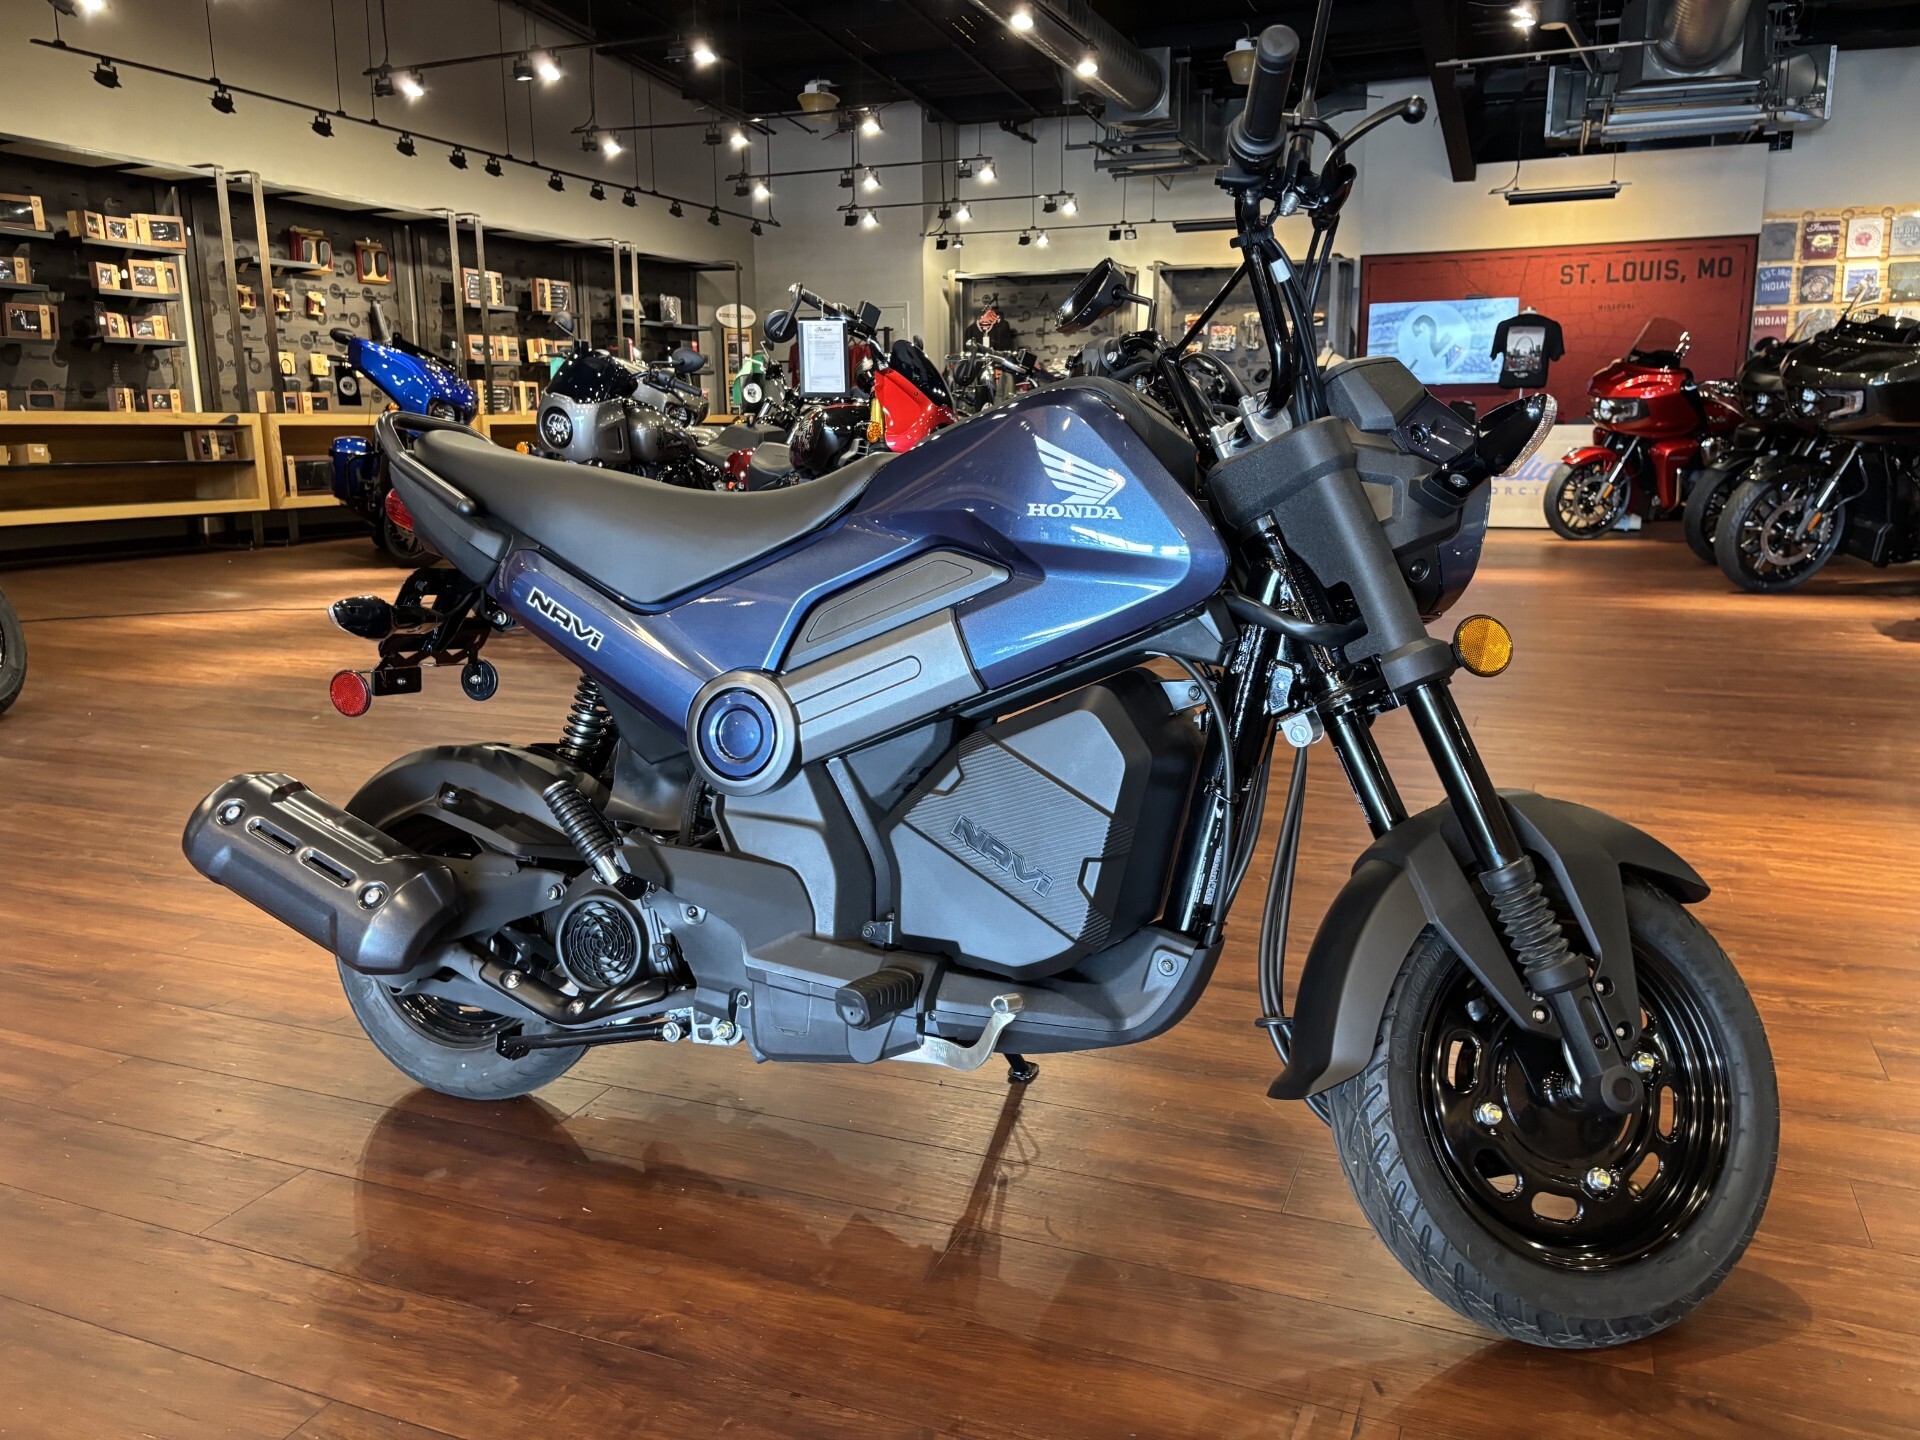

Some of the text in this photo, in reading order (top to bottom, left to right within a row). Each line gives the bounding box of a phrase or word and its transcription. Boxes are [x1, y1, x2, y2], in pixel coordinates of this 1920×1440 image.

[1560, 256, 1734, 285] ST. LOUIS, MO
[1761, 280, 1792, 292] INDIAN
[1754, 315, 1788, 327] INDIAN
[1026, 502, 1123, 520] HONDA
